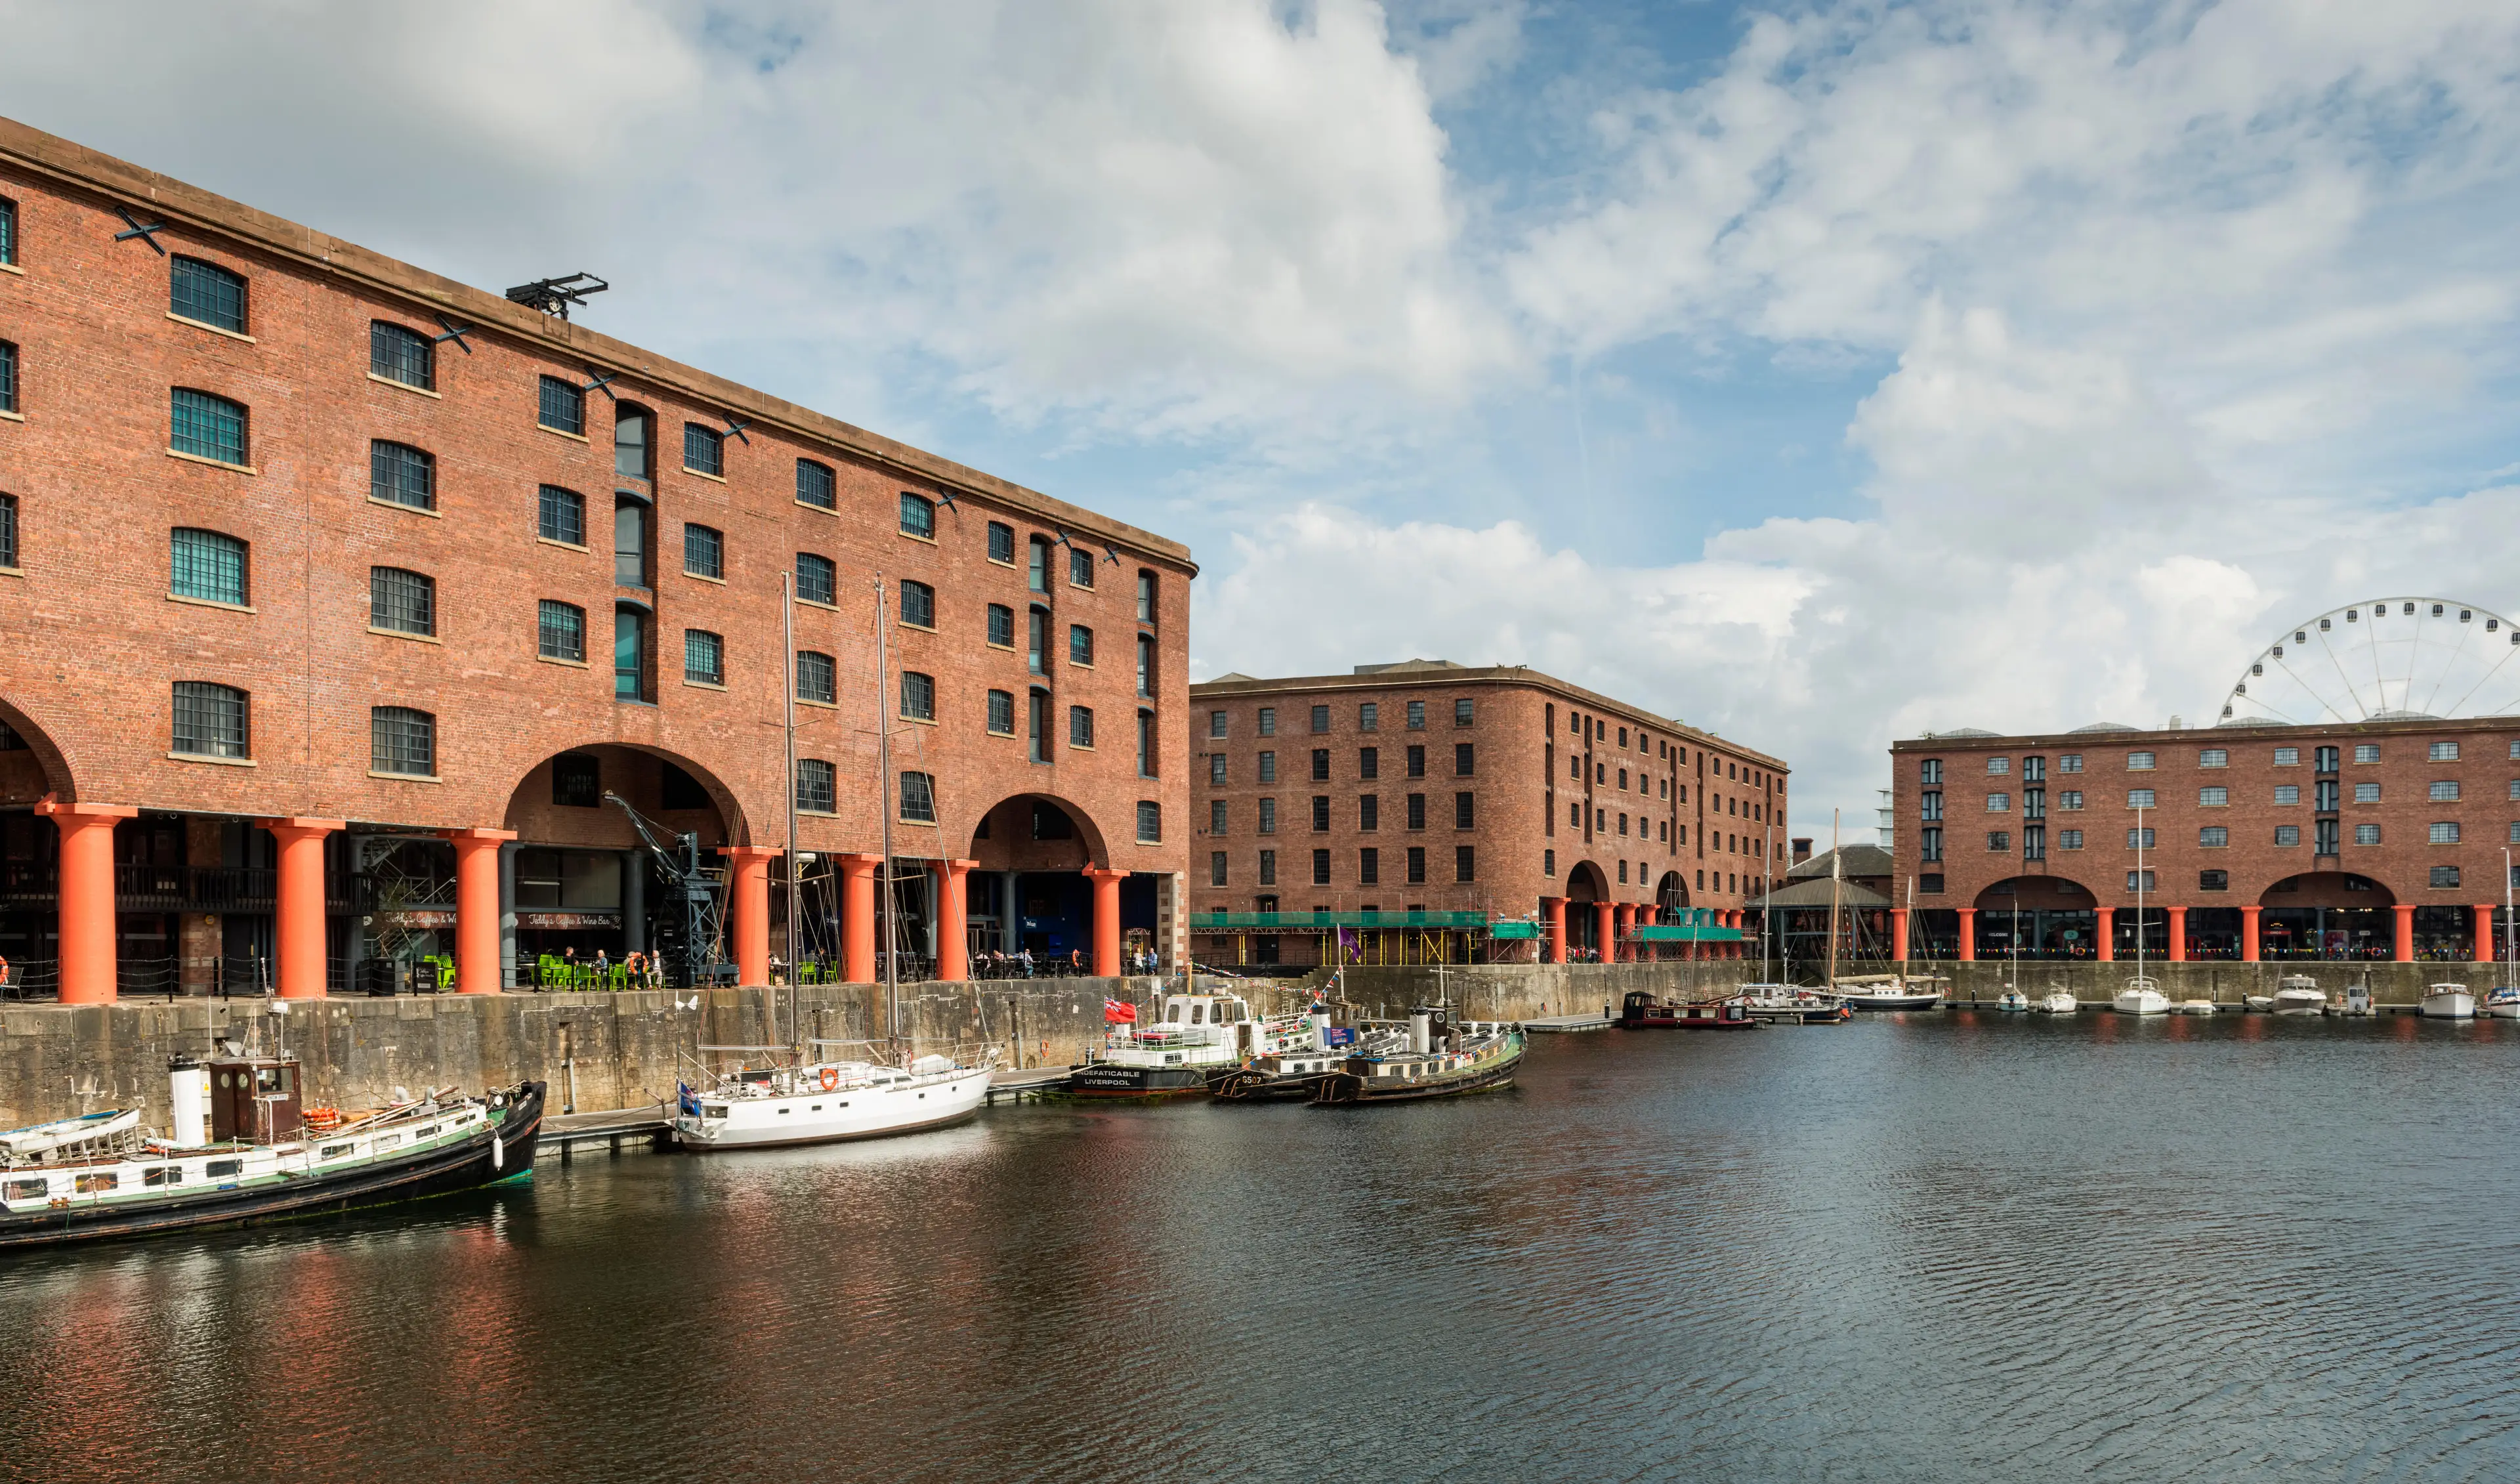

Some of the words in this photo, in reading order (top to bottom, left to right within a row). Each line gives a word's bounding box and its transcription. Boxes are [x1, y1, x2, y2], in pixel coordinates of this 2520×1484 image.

[417, 913, 439, 926] Coffee
[447, 913, 456, 923] Wi
[529, 914, 555, 927] Teddy's
[556, 915, 575, 929] Coffee
[582, 916, 597, 925] Wine
[598, 916, 610, 925] Bar
